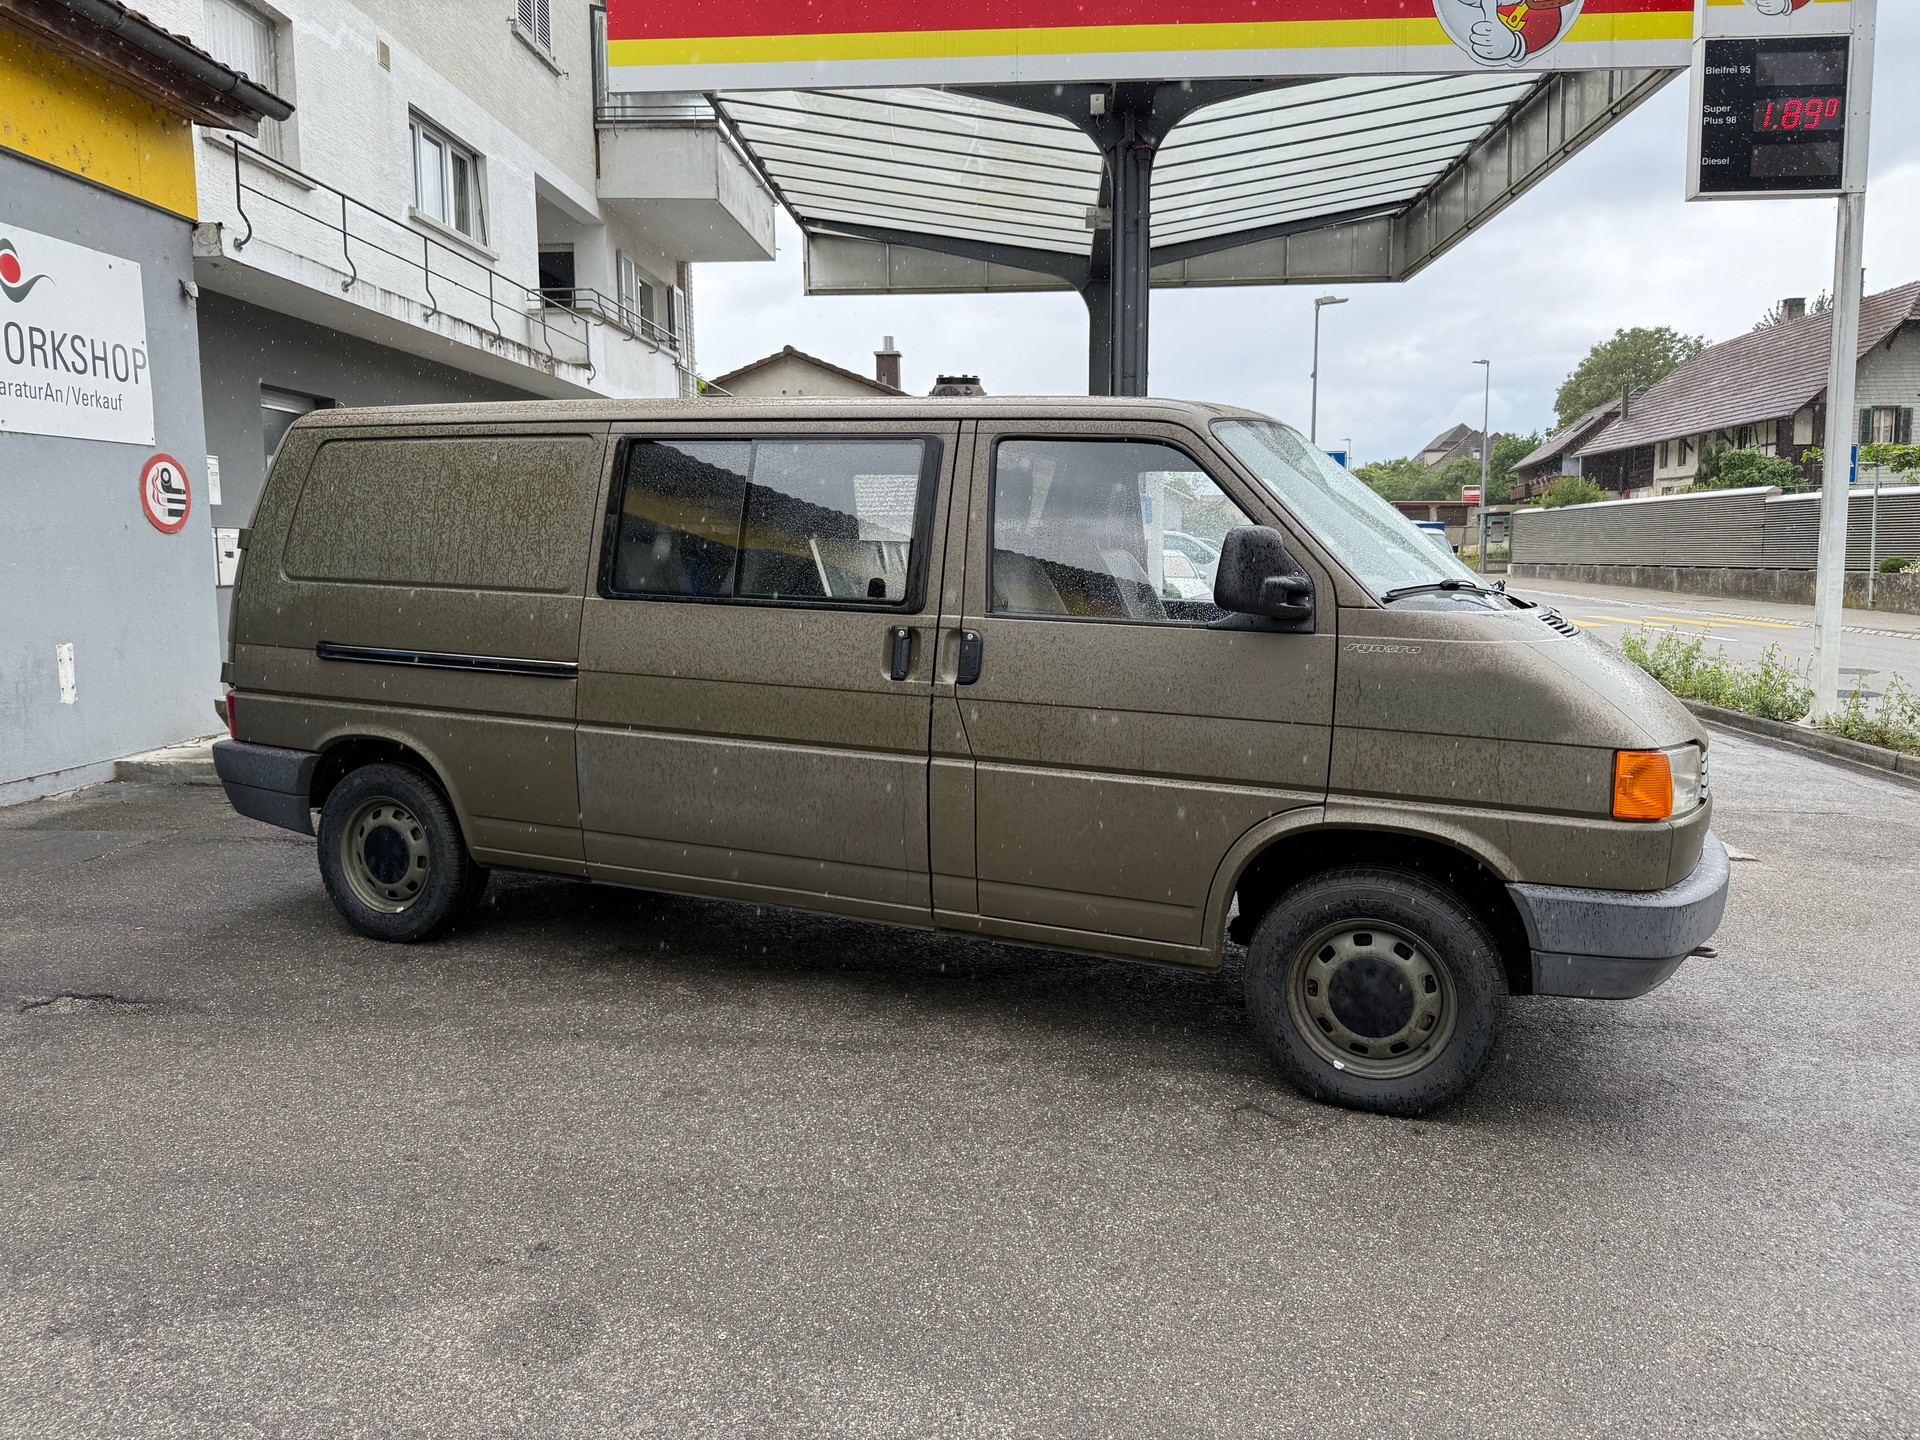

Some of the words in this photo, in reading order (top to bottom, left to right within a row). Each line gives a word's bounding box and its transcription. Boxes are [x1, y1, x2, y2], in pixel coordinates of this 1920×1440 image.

[1705, 66, 1738, 75] Bleifrei
[1739, 65, 1751, 74] 95
[1703, 105, 1732, 114] Super
[1703, 116, 1724, 125] Plus
[1725, 116, 1737, 125] 98
[1702, 157, 1730, 166] Diesel
